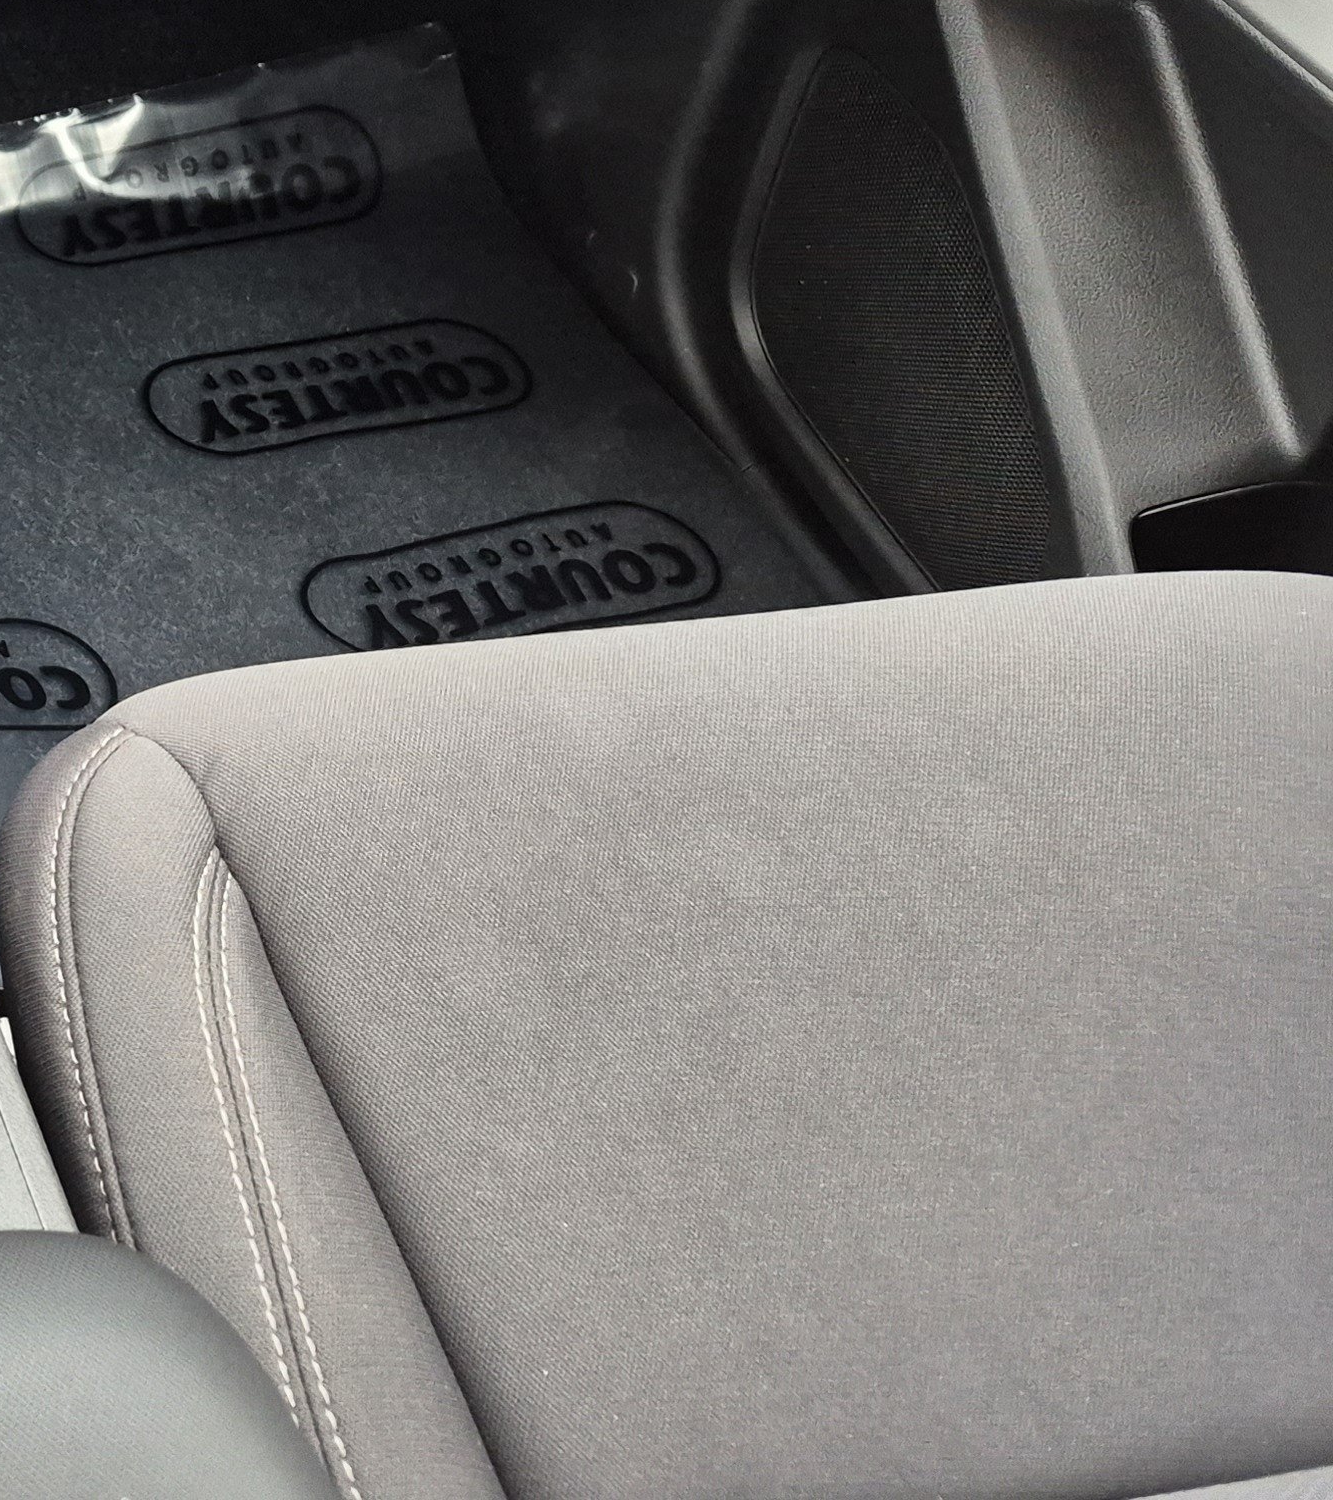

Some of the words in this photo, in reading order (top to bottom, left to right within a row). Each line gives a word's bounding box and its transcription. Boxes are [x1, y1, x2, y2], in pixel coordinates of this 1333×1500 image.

[199, 356, 509, 444] COURTESY
[203, 339, 434, 388] AUTOGROUP
[363, 521, 615, 596] AUTOGROUP
[364, 541, 699, 650] COURTESY
